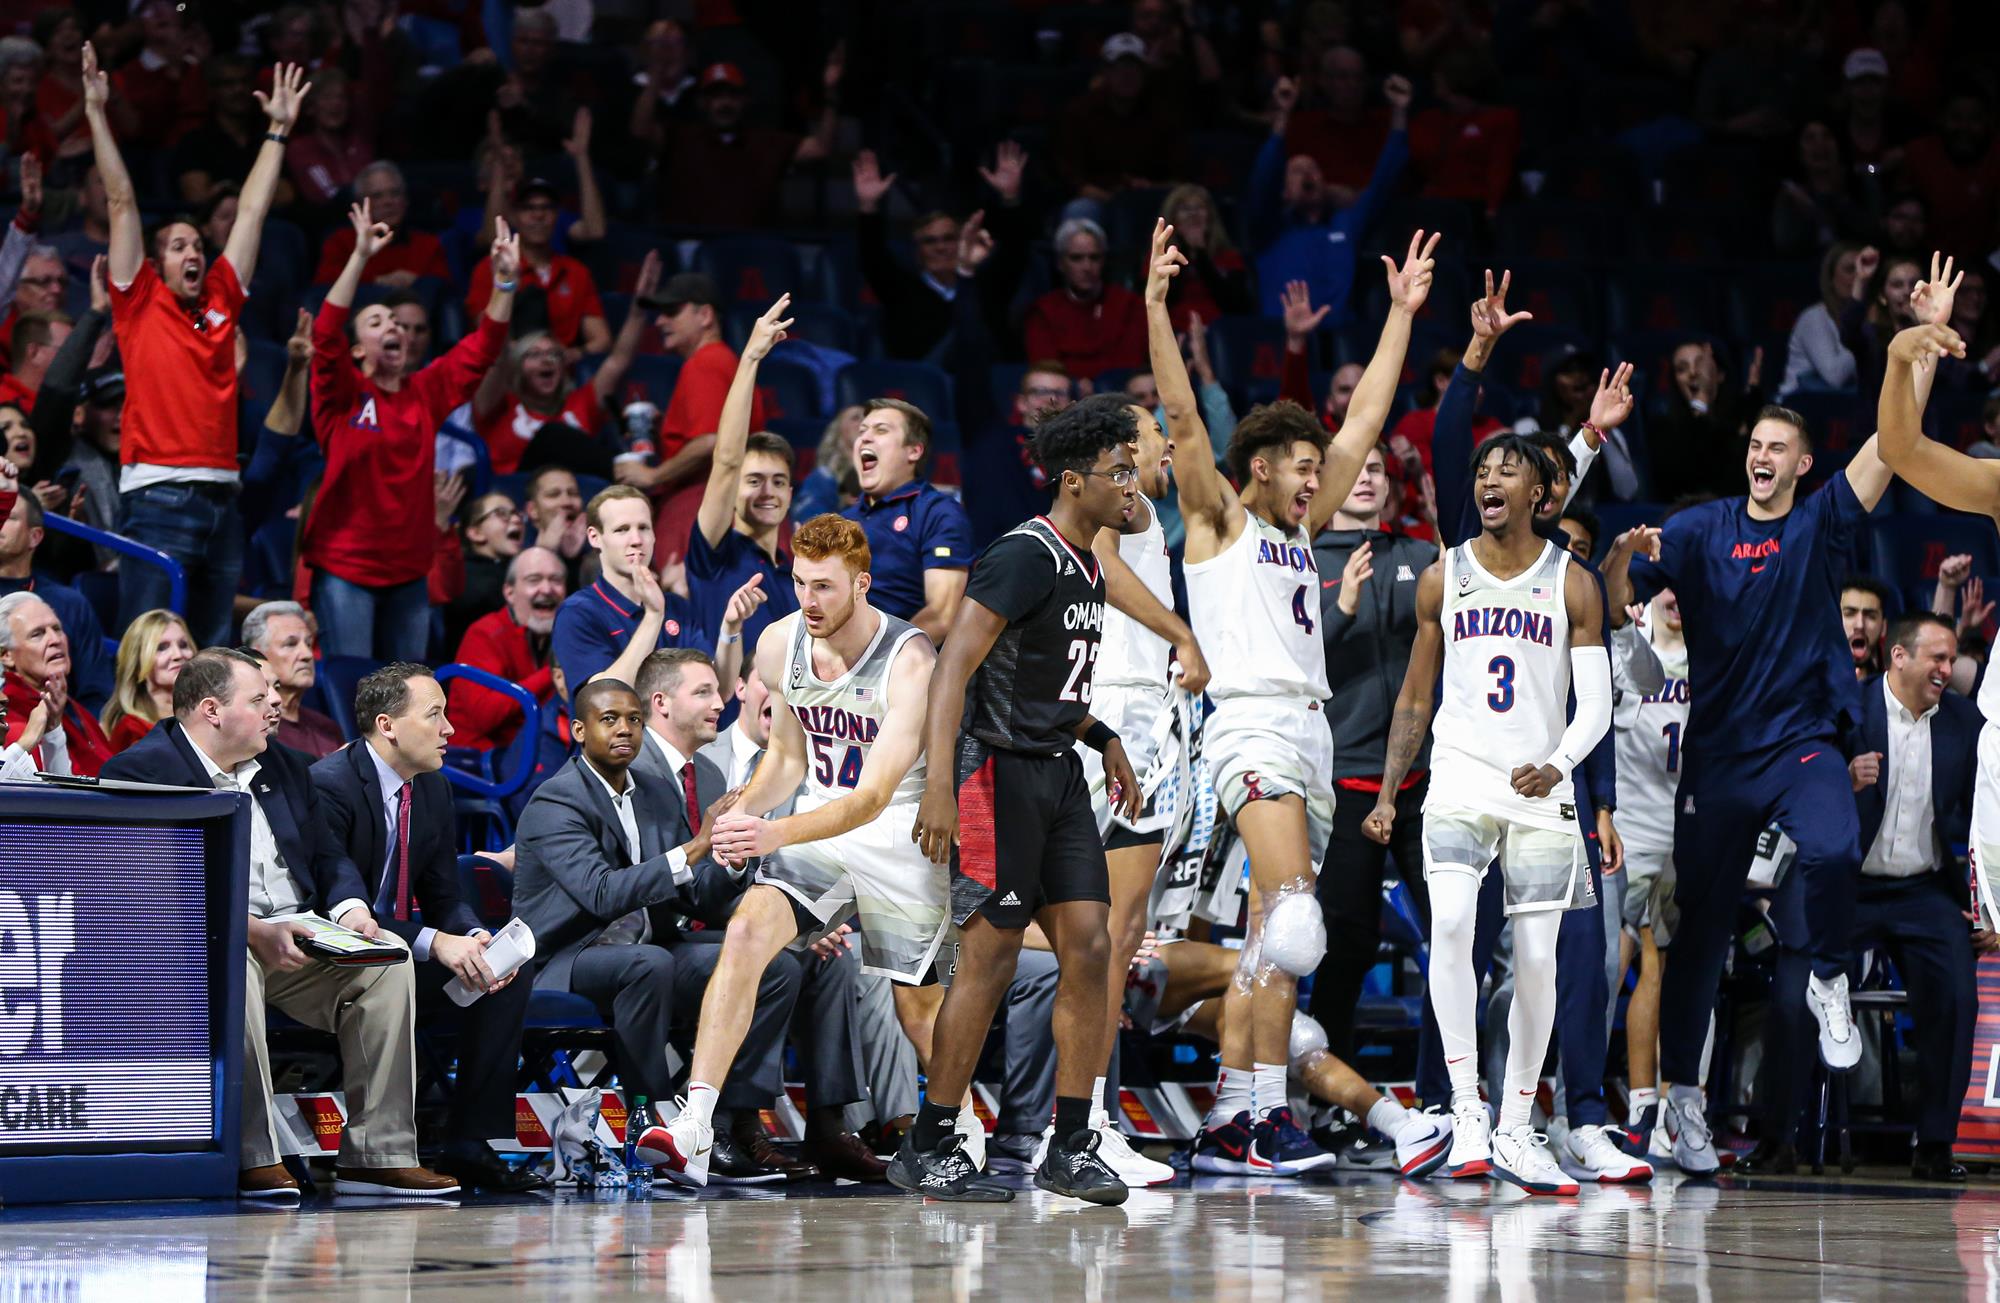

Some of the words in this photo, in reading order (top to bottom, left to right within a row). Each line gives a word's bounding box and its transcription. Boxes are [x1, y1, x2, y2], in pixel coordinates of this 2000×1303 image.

[1291, 584, 1315, 635] 4
[1453, 607, 1553, 648] ARIZONA
[1059, 639, 1100, 704] 23
[1487, 655, 1516, 713] 3
[788, 704, 880, 743] RIZONA
[811, 734, 864, 789] 54
[0, 1086, 88, 1130] CARE
[314, 1112, 342, 1123] ELLS
